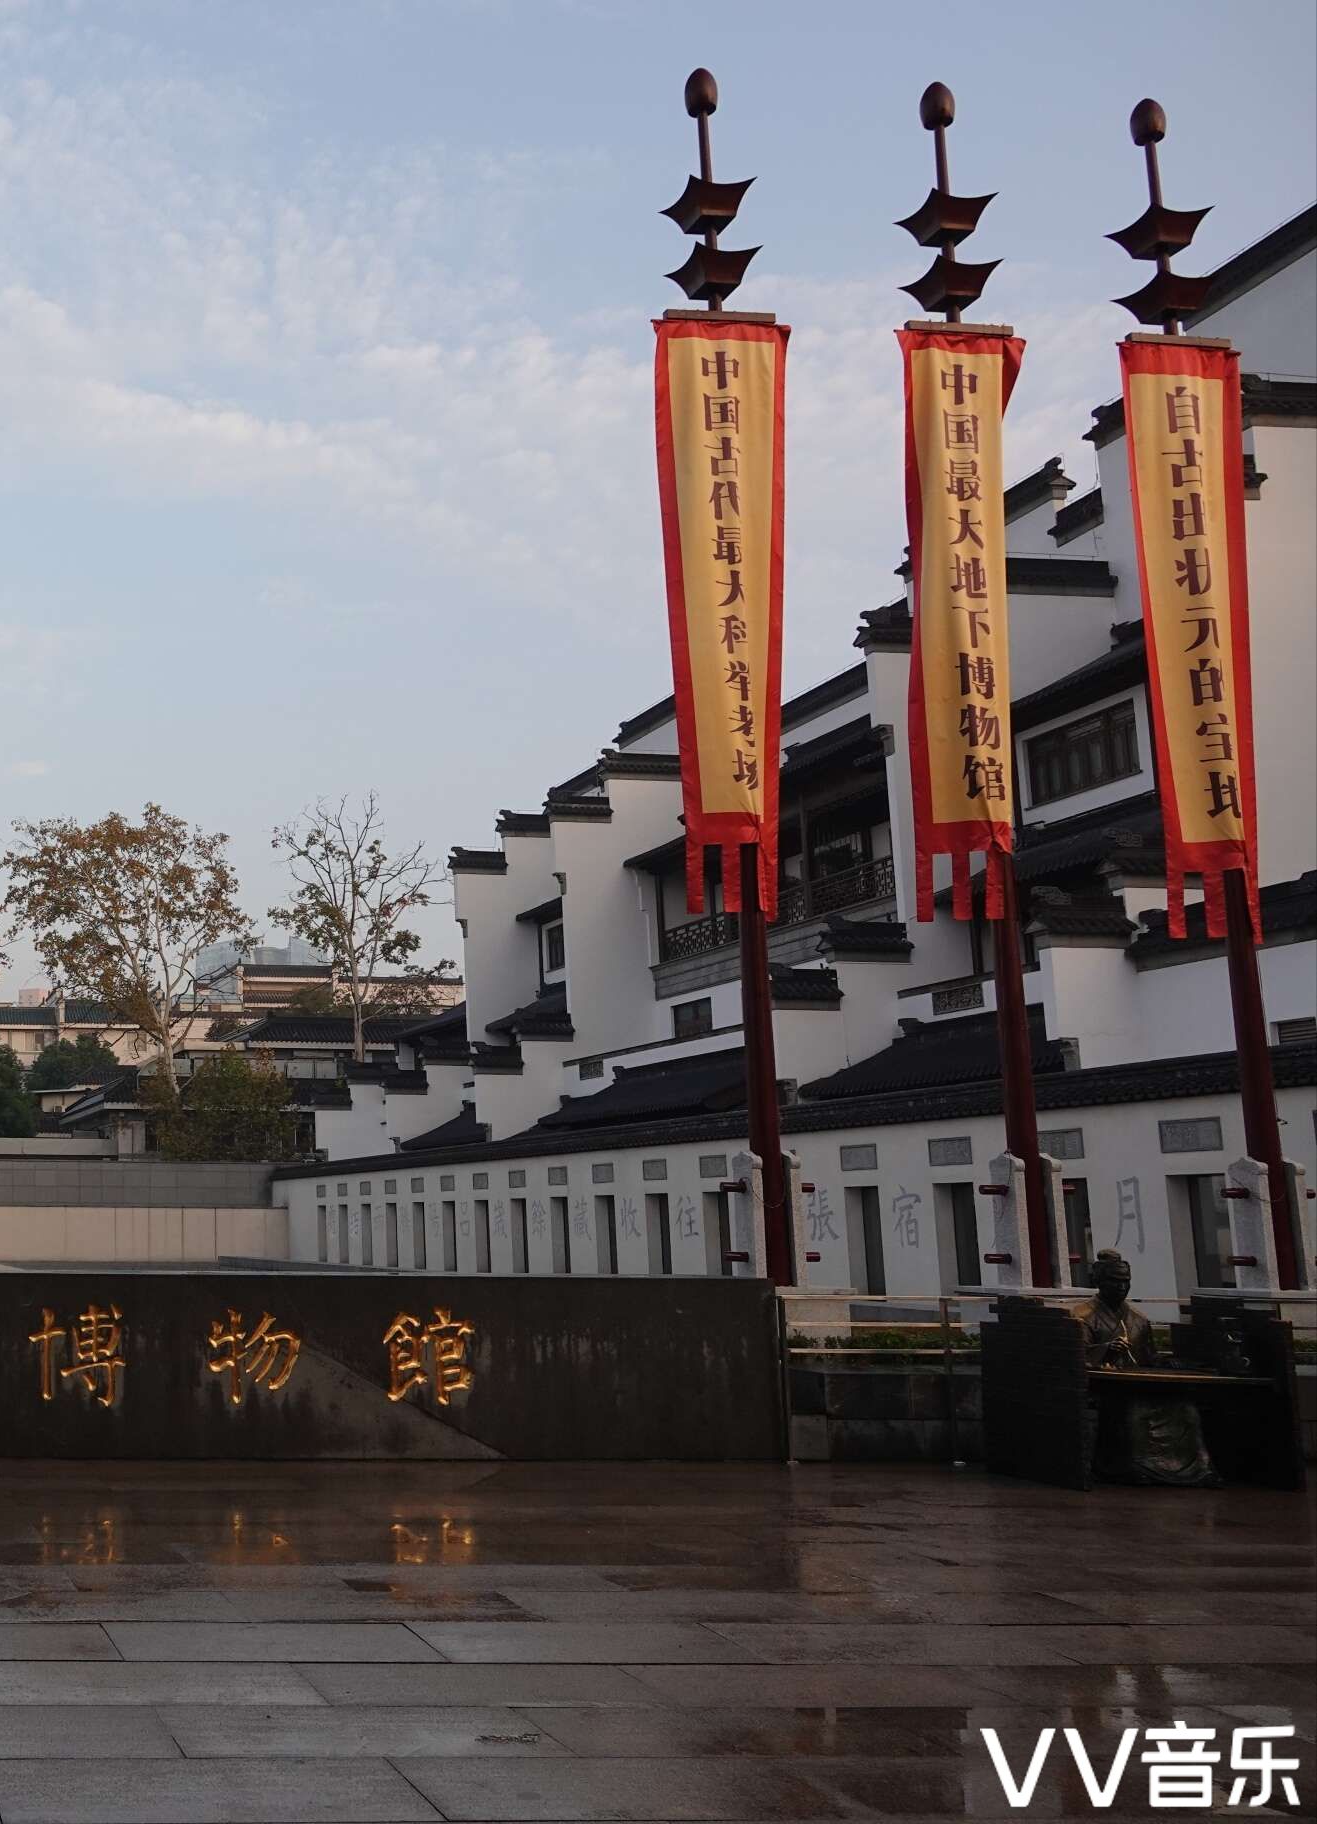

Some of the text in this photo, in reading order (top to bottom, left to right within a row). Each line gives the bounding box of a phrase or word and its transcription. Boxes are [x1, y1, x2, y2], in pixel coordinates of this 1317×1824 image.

[700, 350, 760, 790] 中国古代最大科举考场
[940, 363, 1005, 801] 中国最大地下博物馆
[1161, 385, 1243, 819] 自古出状元的宝地
[620, 1197, 642, 1240] 收
[675, 1195, 699, 1240] 往
[806, 1188, 840, 1241] 張
[892, 1183, 922, 1248] 宿
[1114, 1175, 1145, 1253] 月
